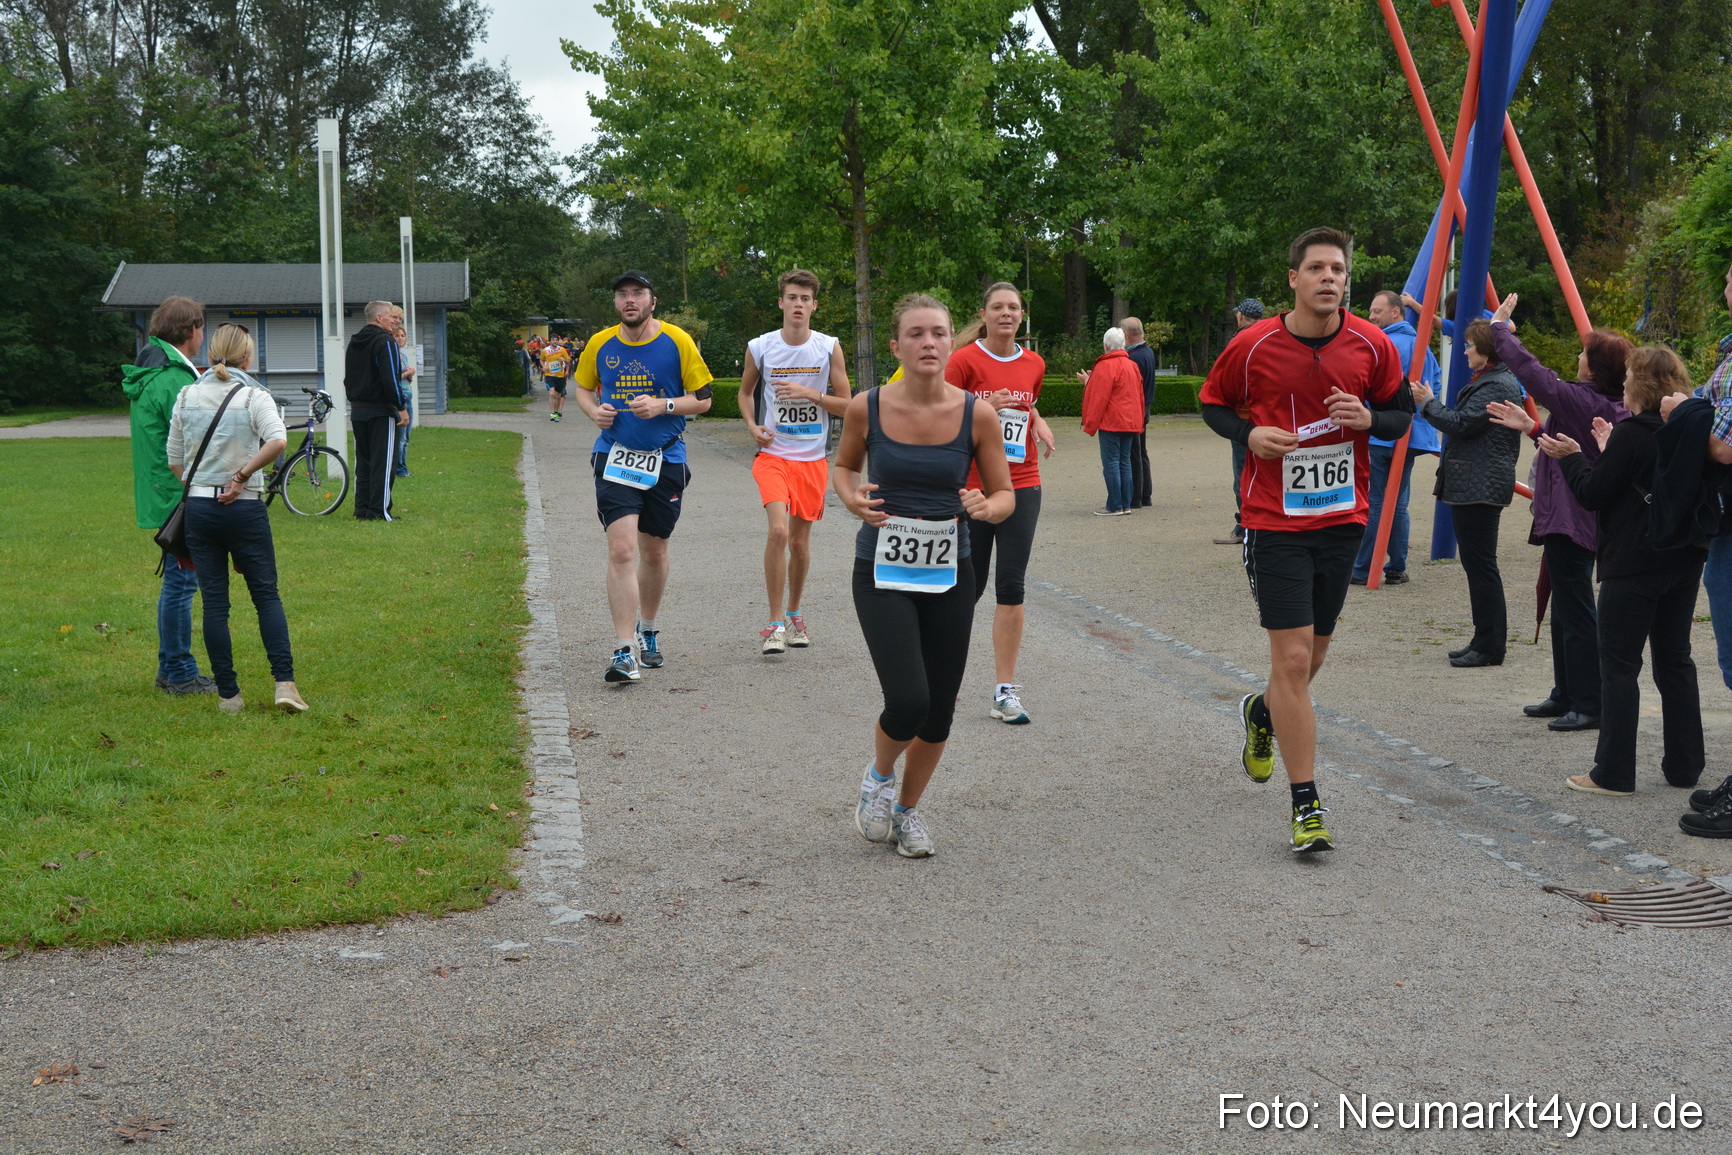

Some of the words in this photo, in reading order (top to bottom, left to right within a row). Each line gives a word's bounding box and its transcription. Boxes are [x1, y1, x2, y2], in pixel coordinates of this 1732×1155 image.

[778, 406, 818, 423] 2053
[787, 426, 810, 434] Markus
[1310, 423, 1329, 434] DEHN
[613, 450, 657, 472] 2620
[1311, 450, 1344, 460] Neumarkt
[620, 470, 642, 483] Ronny
[1291, 459, 1349, 490] 2166
[1302, 493, 1339, 506] Andreas
[911, 526, 948, 536] Neumarkt
[884, 534, 952, 565] 3312
